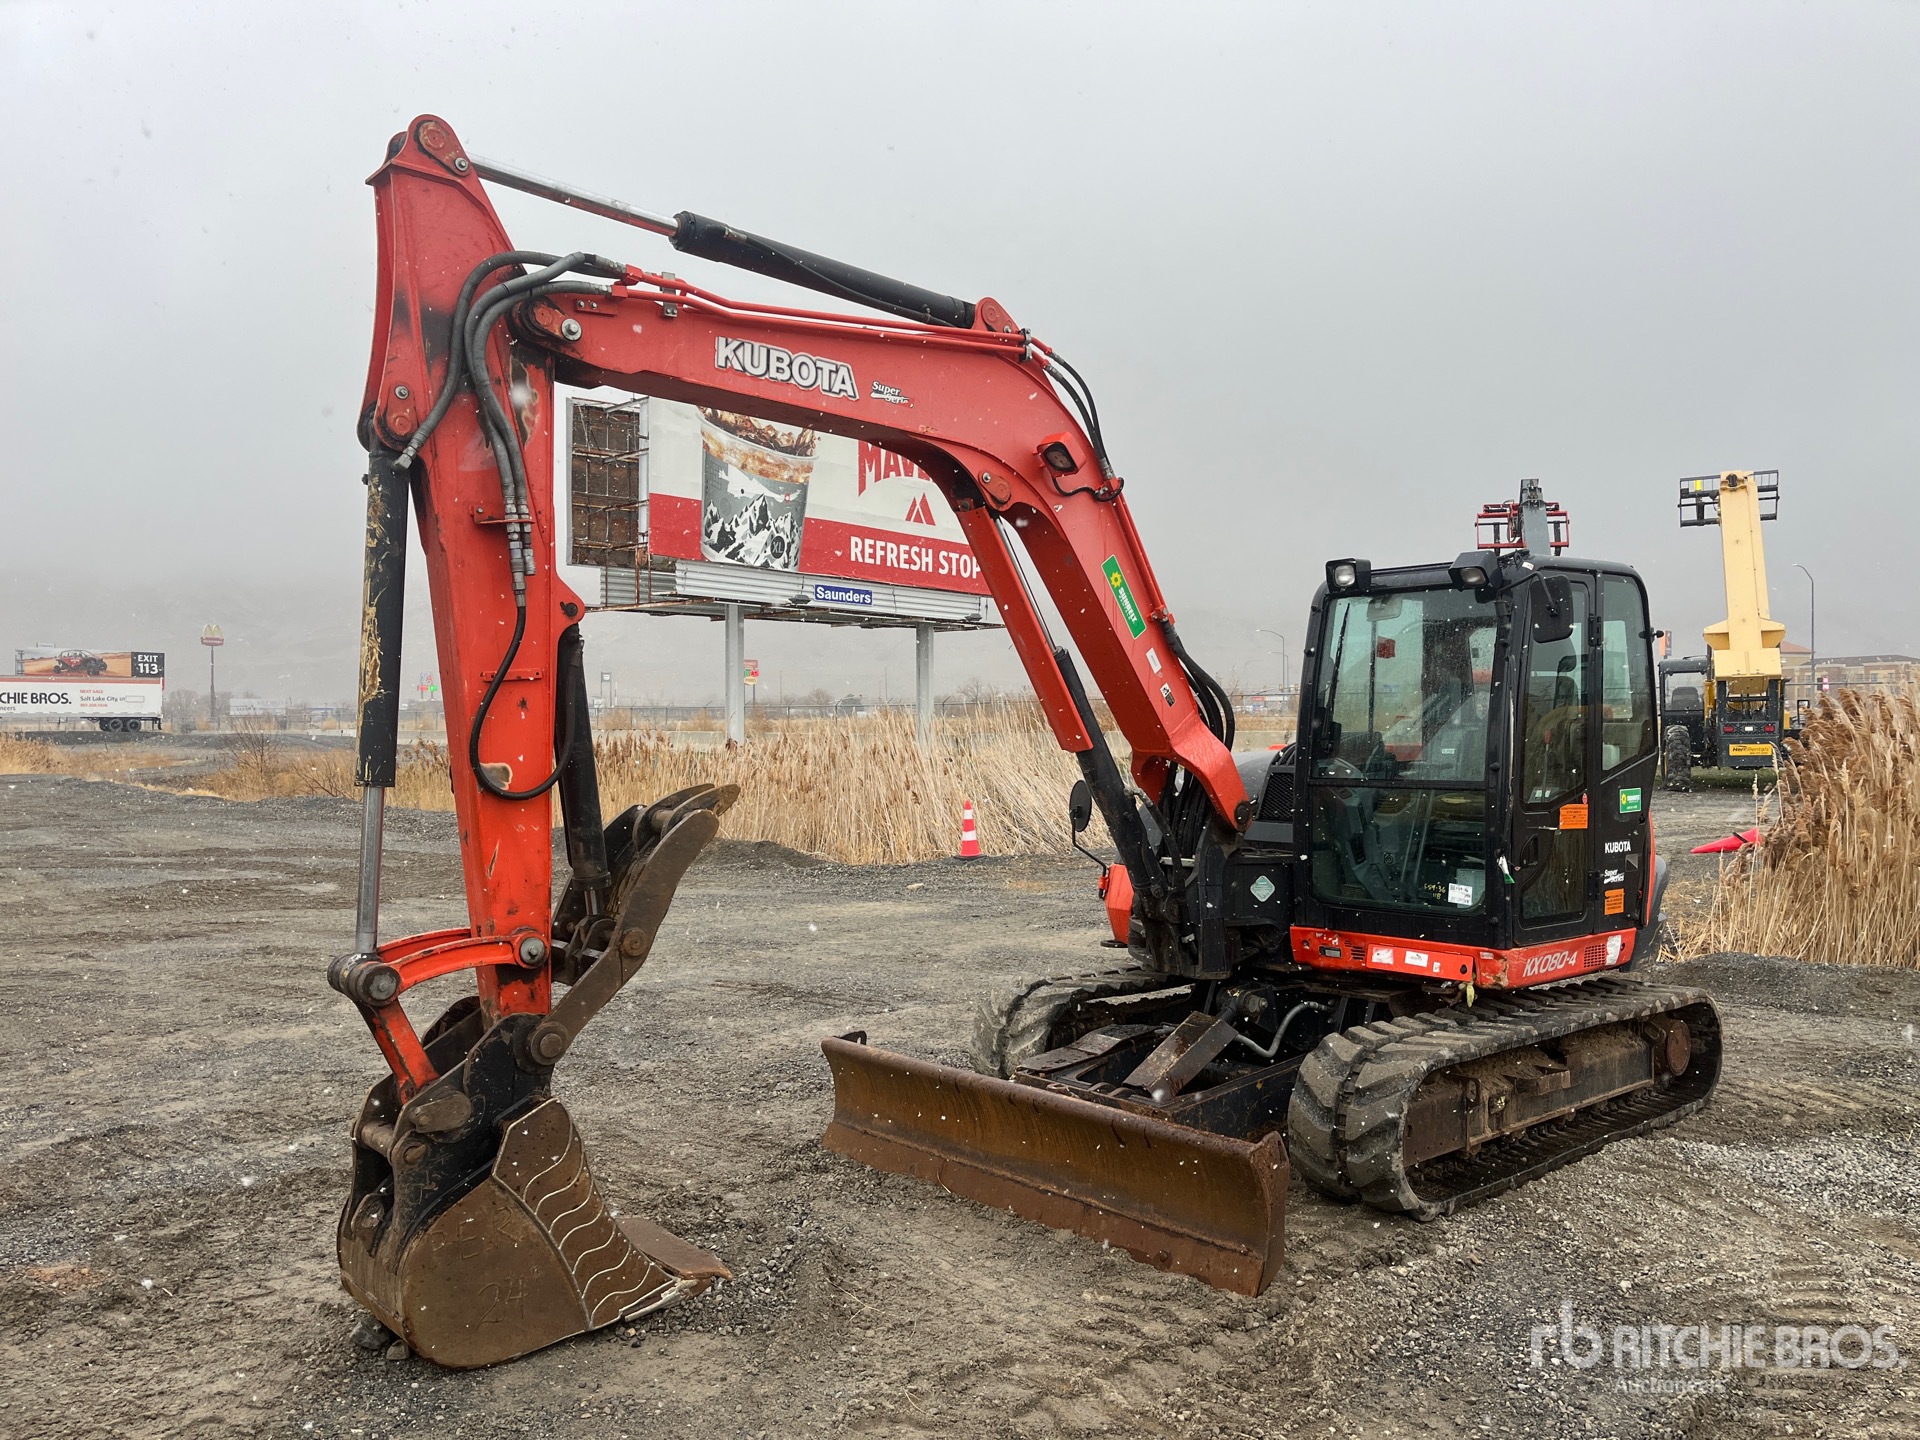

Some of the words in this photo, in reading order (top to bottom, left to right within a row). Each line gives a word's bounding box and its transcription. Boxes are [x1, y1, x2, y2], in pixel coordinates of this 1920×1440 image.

[716, 336, 858, 399] KUBOTA
[872, 381, 901, 396] Super
[772, 541, 784, 554] XL
[851, 536, 933, 573] REFRESH
[938, 551, 981, 579] STOP
[816, 586, 872, 604] Saunders
[137, 654, 158, 663] EXIT
[138, 663, 159, 674] 113
[31, 692, 72, 704] BROS.
[1604, 841, 1631, 854] KUBOTA
[1604, 869, 1618, 877] Super
[1522, 950, 1578, 978] KX080-4
